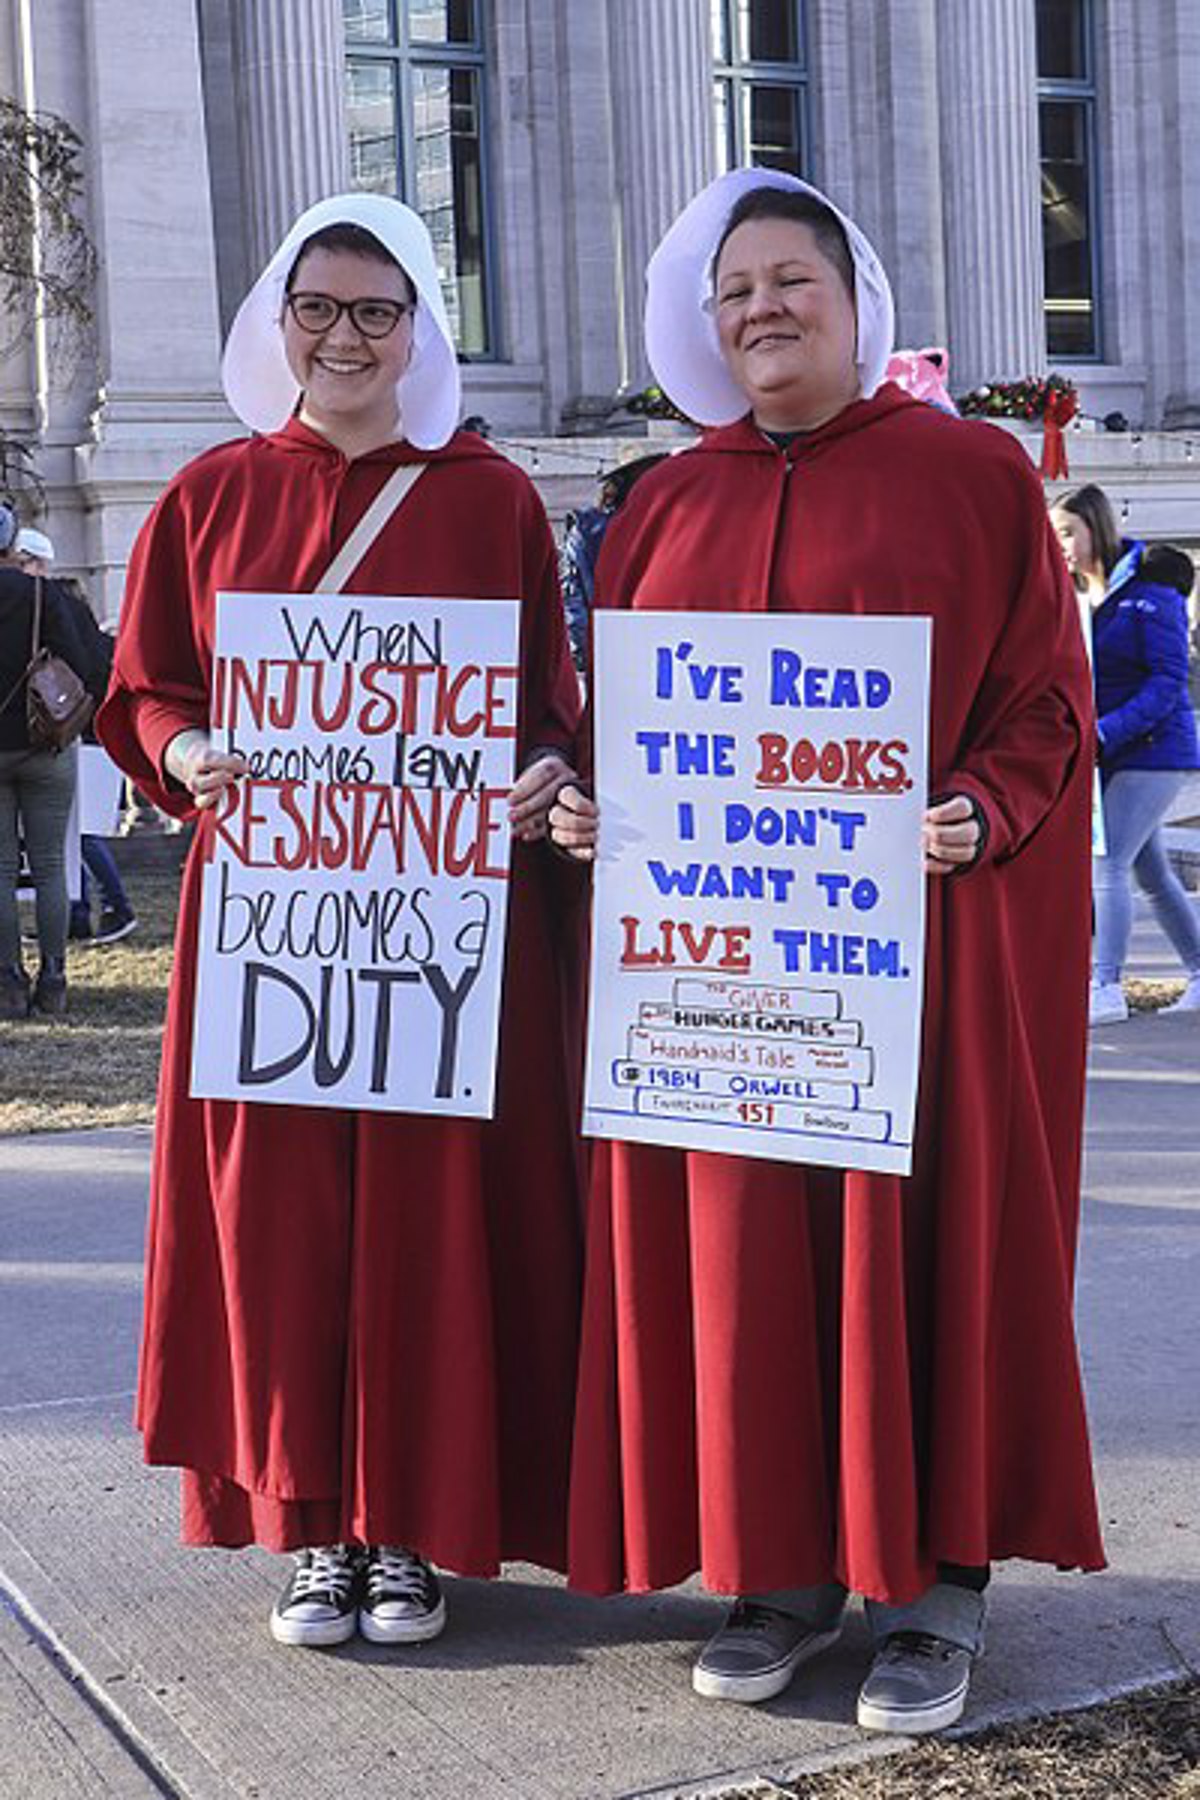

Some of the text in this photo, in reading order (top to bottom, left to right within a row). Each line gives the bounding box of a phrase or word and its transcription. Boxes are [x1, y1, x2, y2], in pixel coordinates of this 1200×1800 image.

[213, 656, 519, 738] INJUSTICE
[656, 642, 892, 708] I'VE READ
[636, 731, 913, 791] THE BOOKS.
[205, 780, 514, 879] RESISTANCE
[678, 802, 866, 850] I DON'T
[647, 860, 879, 911] WANT TO
[455, 890, 490, 967] a
[620, 916, 910, 977] LIVE THEM.
[237, 961, 481, 1098] DUTY.
[755, 1045, 796, 1068] Tale
[649, 1066, 819, 1098] 1984 ORWELL
